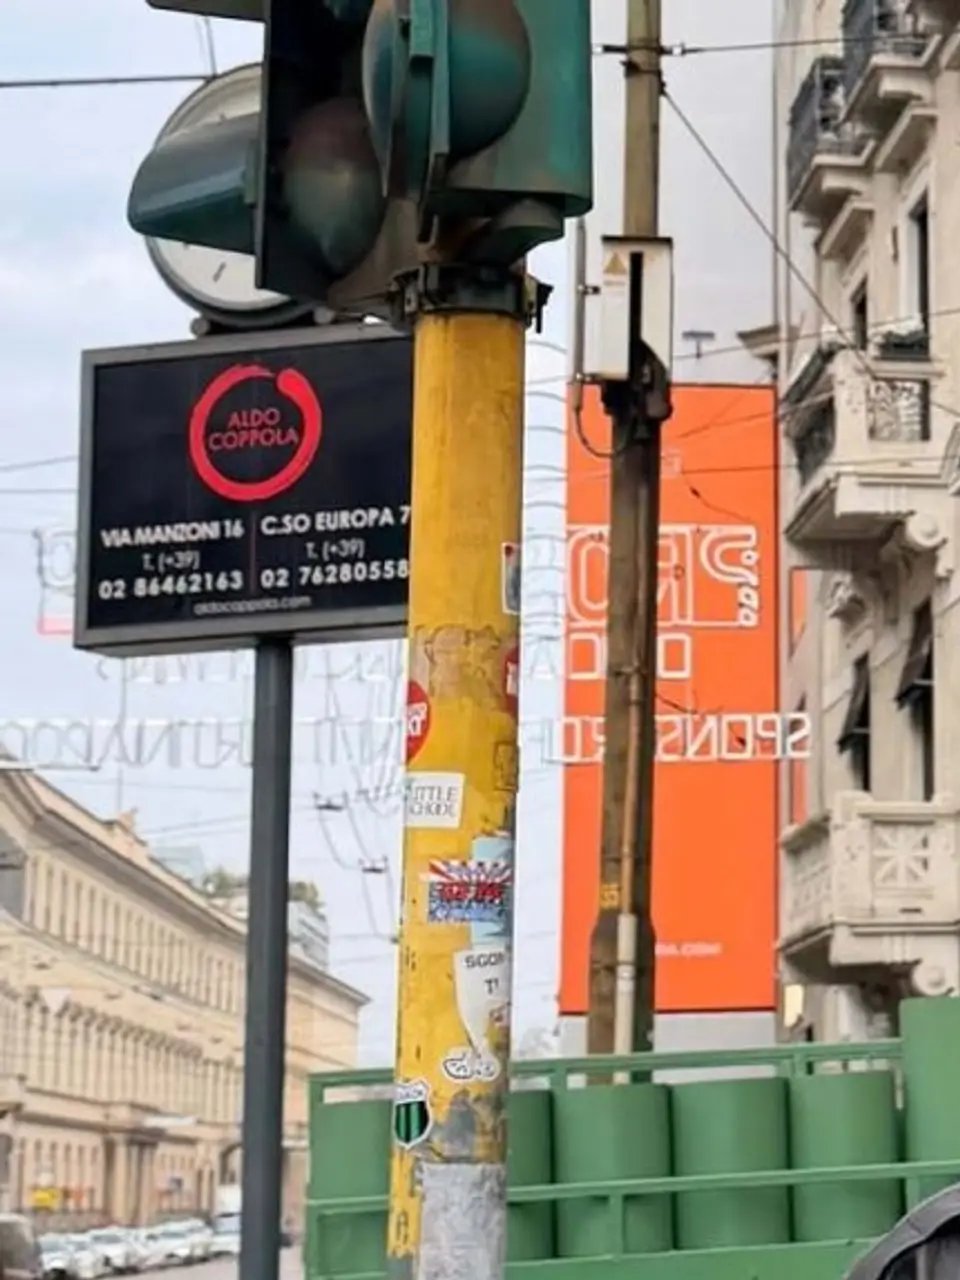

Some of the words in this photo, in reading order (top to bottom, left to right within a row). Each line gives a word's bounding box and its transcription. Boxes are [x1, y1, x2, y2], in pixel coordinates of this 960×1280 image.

[228, 408, 281, 429] ALDO
[208, 428, 299, 450] COPPOLA
[315, 506, 395, 531] EUROPA
[101, 528, 133, 548] VIA
[134, 520, 220, 545] MANZONI
[223, 518, 245, 538] 16
[260, 568, 290, 589] 02
[299, 559, 410, 586] 76280558
[98, 578, 126, 599] 02
